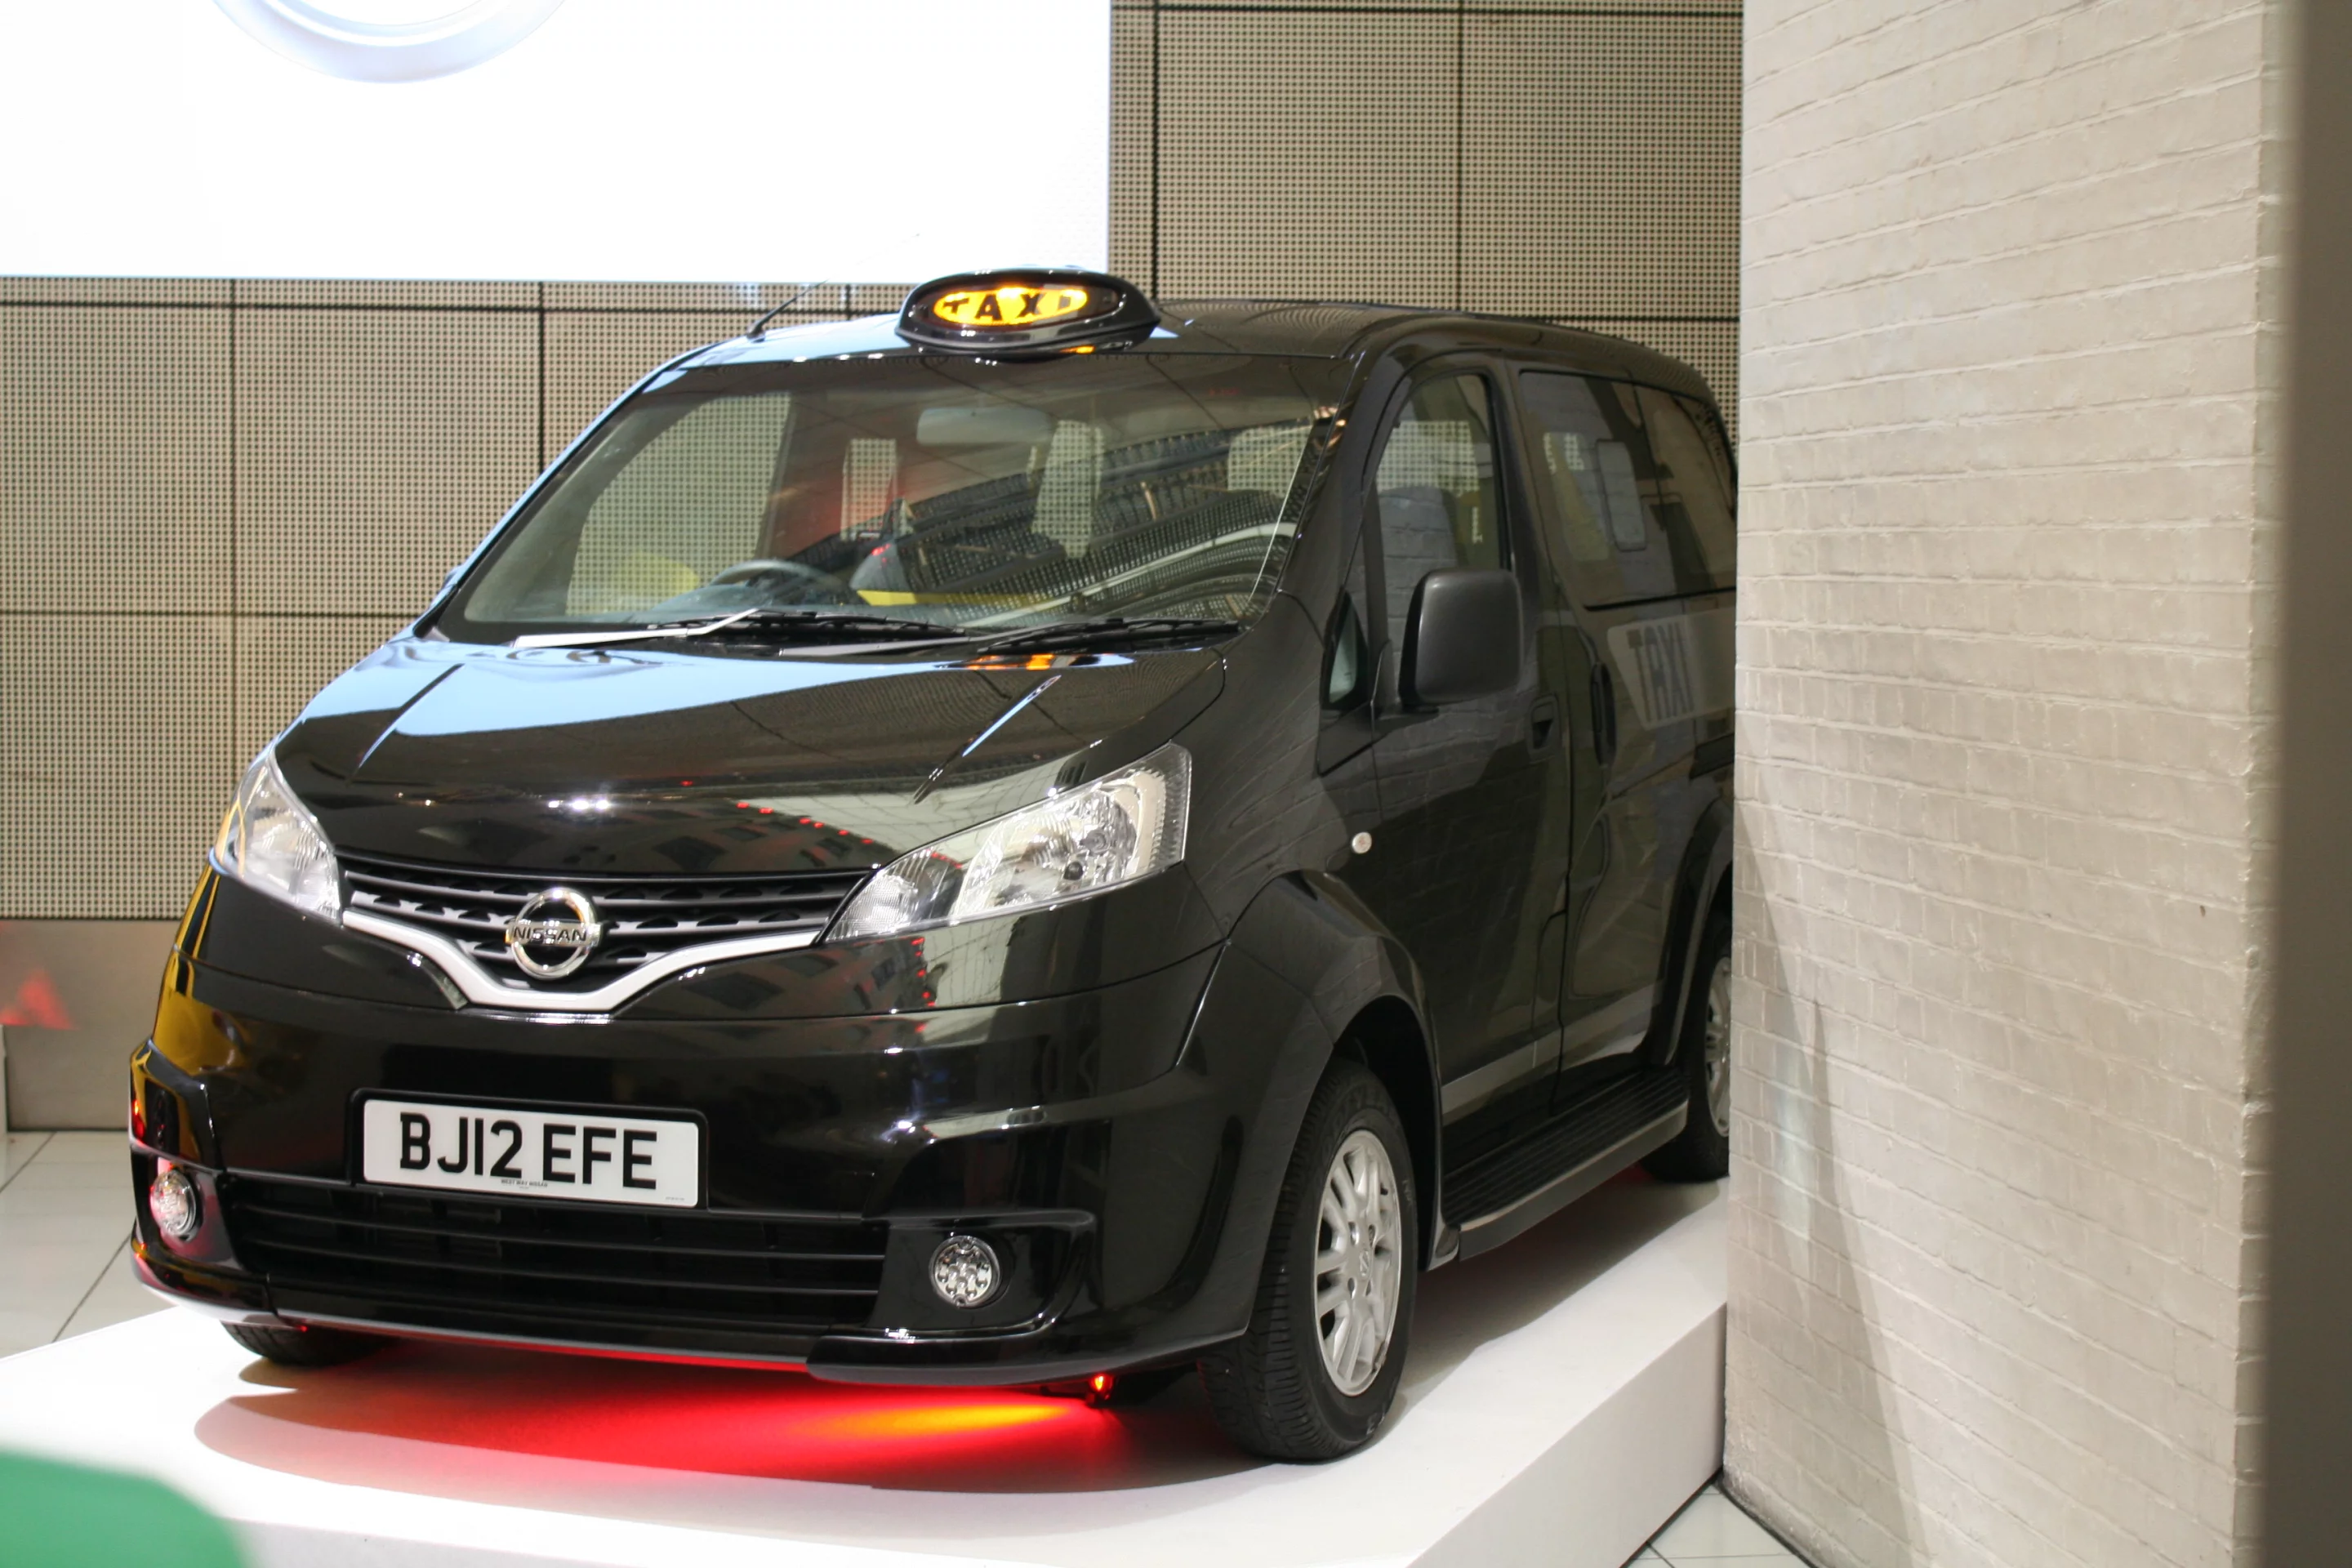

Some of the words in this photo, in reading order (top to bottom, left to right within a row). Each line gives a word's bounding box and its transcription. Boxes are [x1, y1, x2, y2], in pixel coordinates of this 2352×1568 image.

[1627, 623, 1695, 723] TAXI
[513, 925, 587, 942] NISSAN
[542, 1122, 657, 1191] EFE
